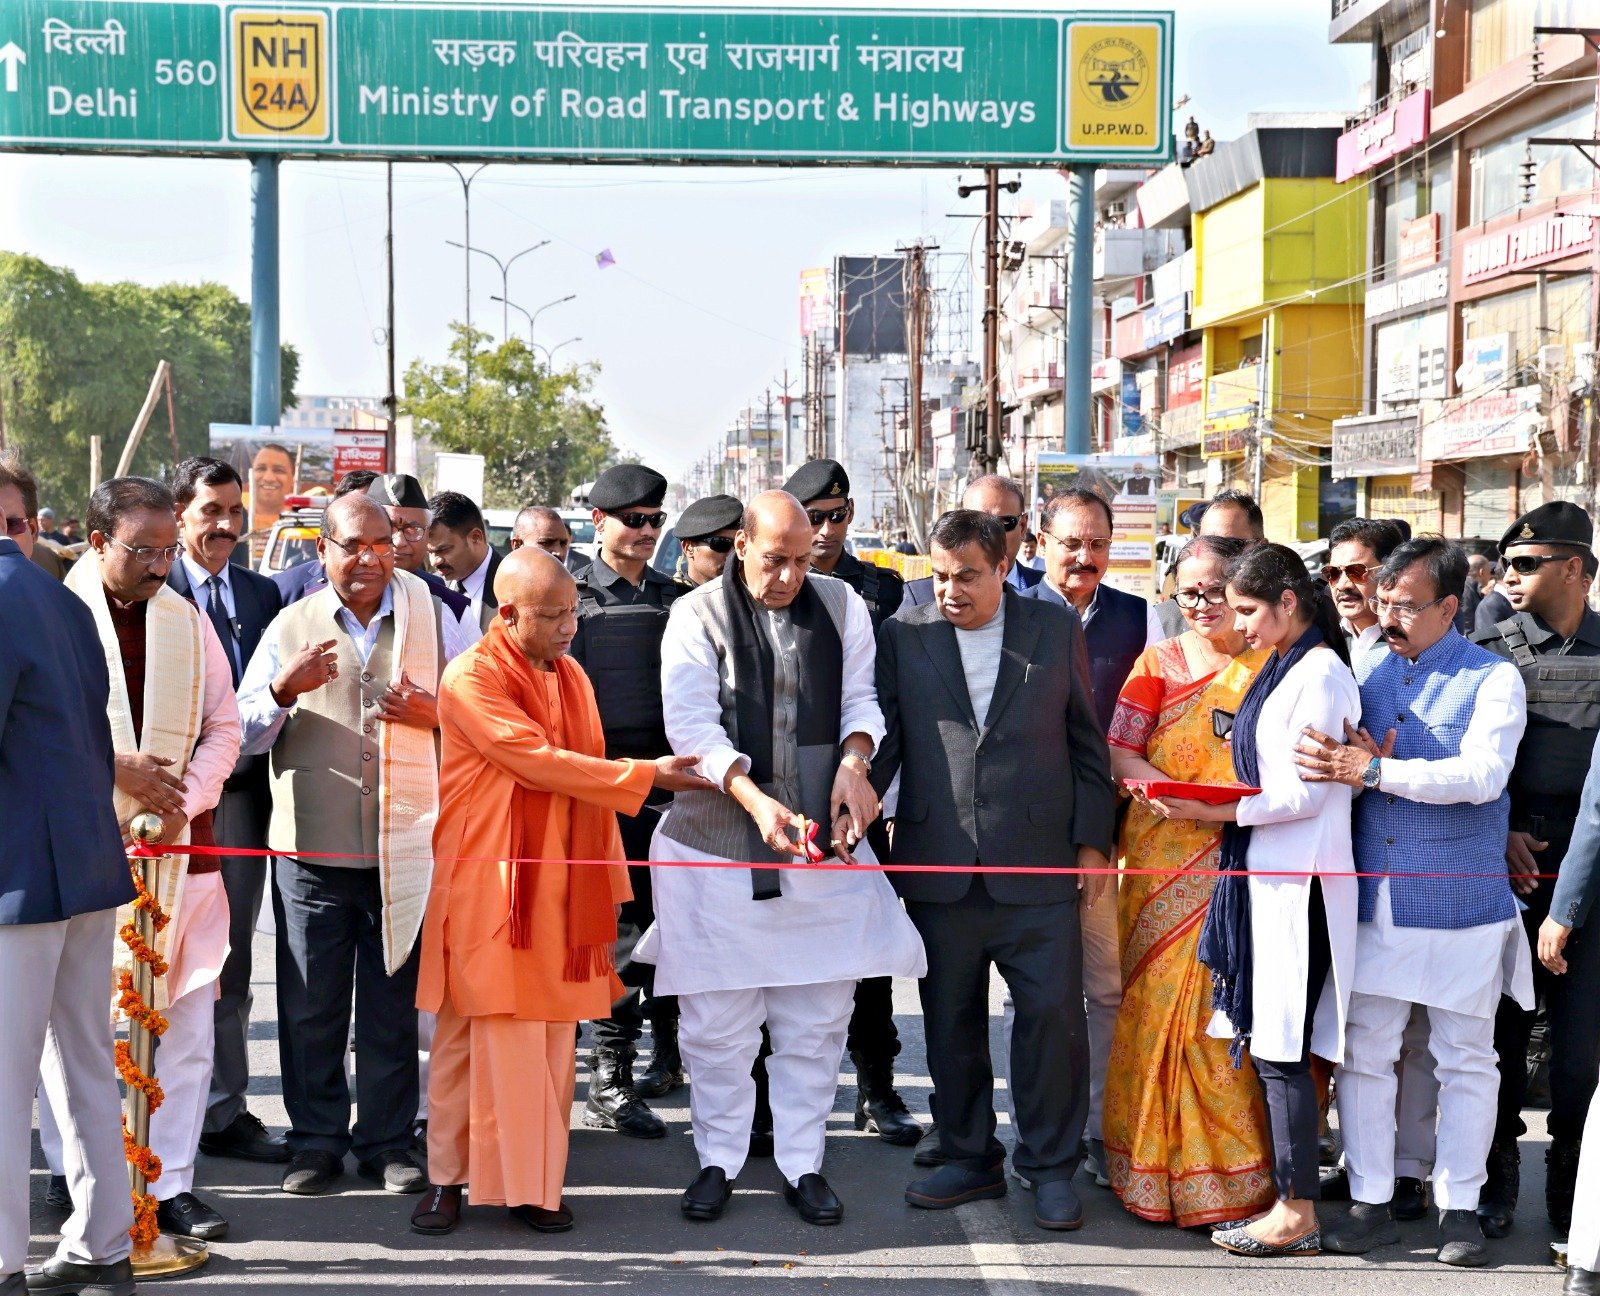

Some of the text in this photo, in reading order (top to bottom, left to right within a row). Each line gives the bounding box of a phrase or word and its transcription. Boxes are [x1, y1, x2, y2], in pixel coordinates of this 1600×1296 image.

[42, 17, 126, 55] दिल्ली
[252, 36, 307, 68] NH
[432, 30, 965, 75] सड़क परिवहन एवं राजमार्ग मंत्रालय
[154, 59, 217, 86] 560
[47, 86, 137, 117] Delhi
[252, 83, 309, 111] 24A
[358, 84, 1036, 128] Ministry of Road Transport & Highways
[1082, 123, 1148, 136] U.P.P.W.D.
[1510, 215, 1594, 264] FURNITURE
